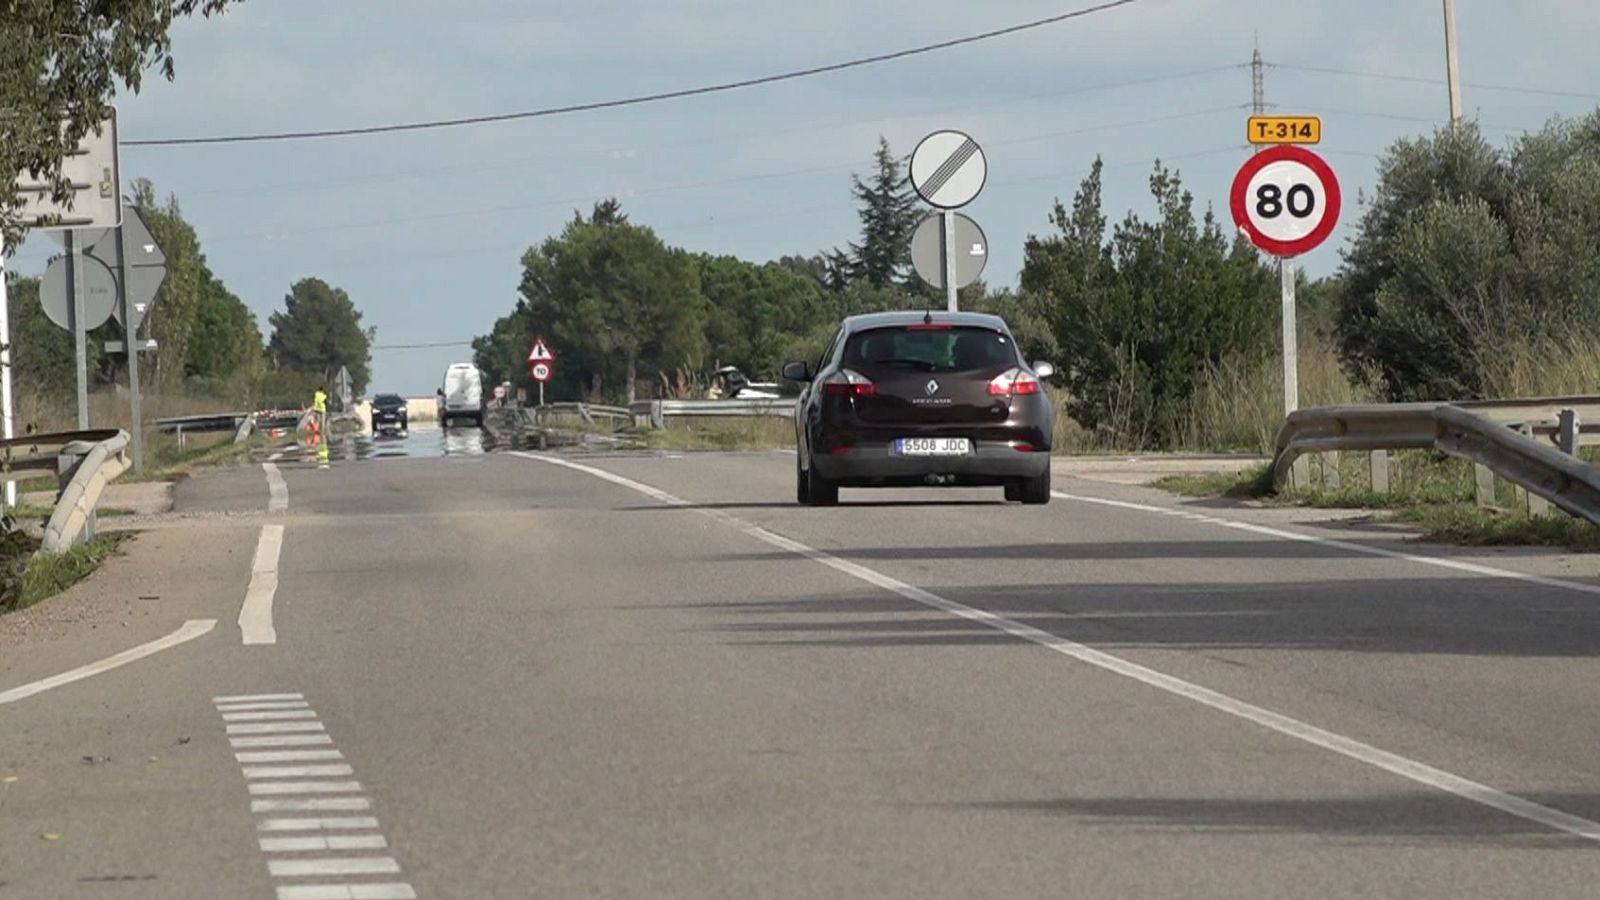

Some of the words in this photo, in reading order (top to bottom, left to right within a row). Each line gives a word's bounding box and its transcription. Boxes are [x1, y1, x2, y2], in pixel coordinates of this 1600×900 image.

[1256, 122, 1312, 138] T-314
[1256, 183, 1315, 219] 80
[905, 439, 936, 450] 5508
[942, 439, 966, 450] JDC
